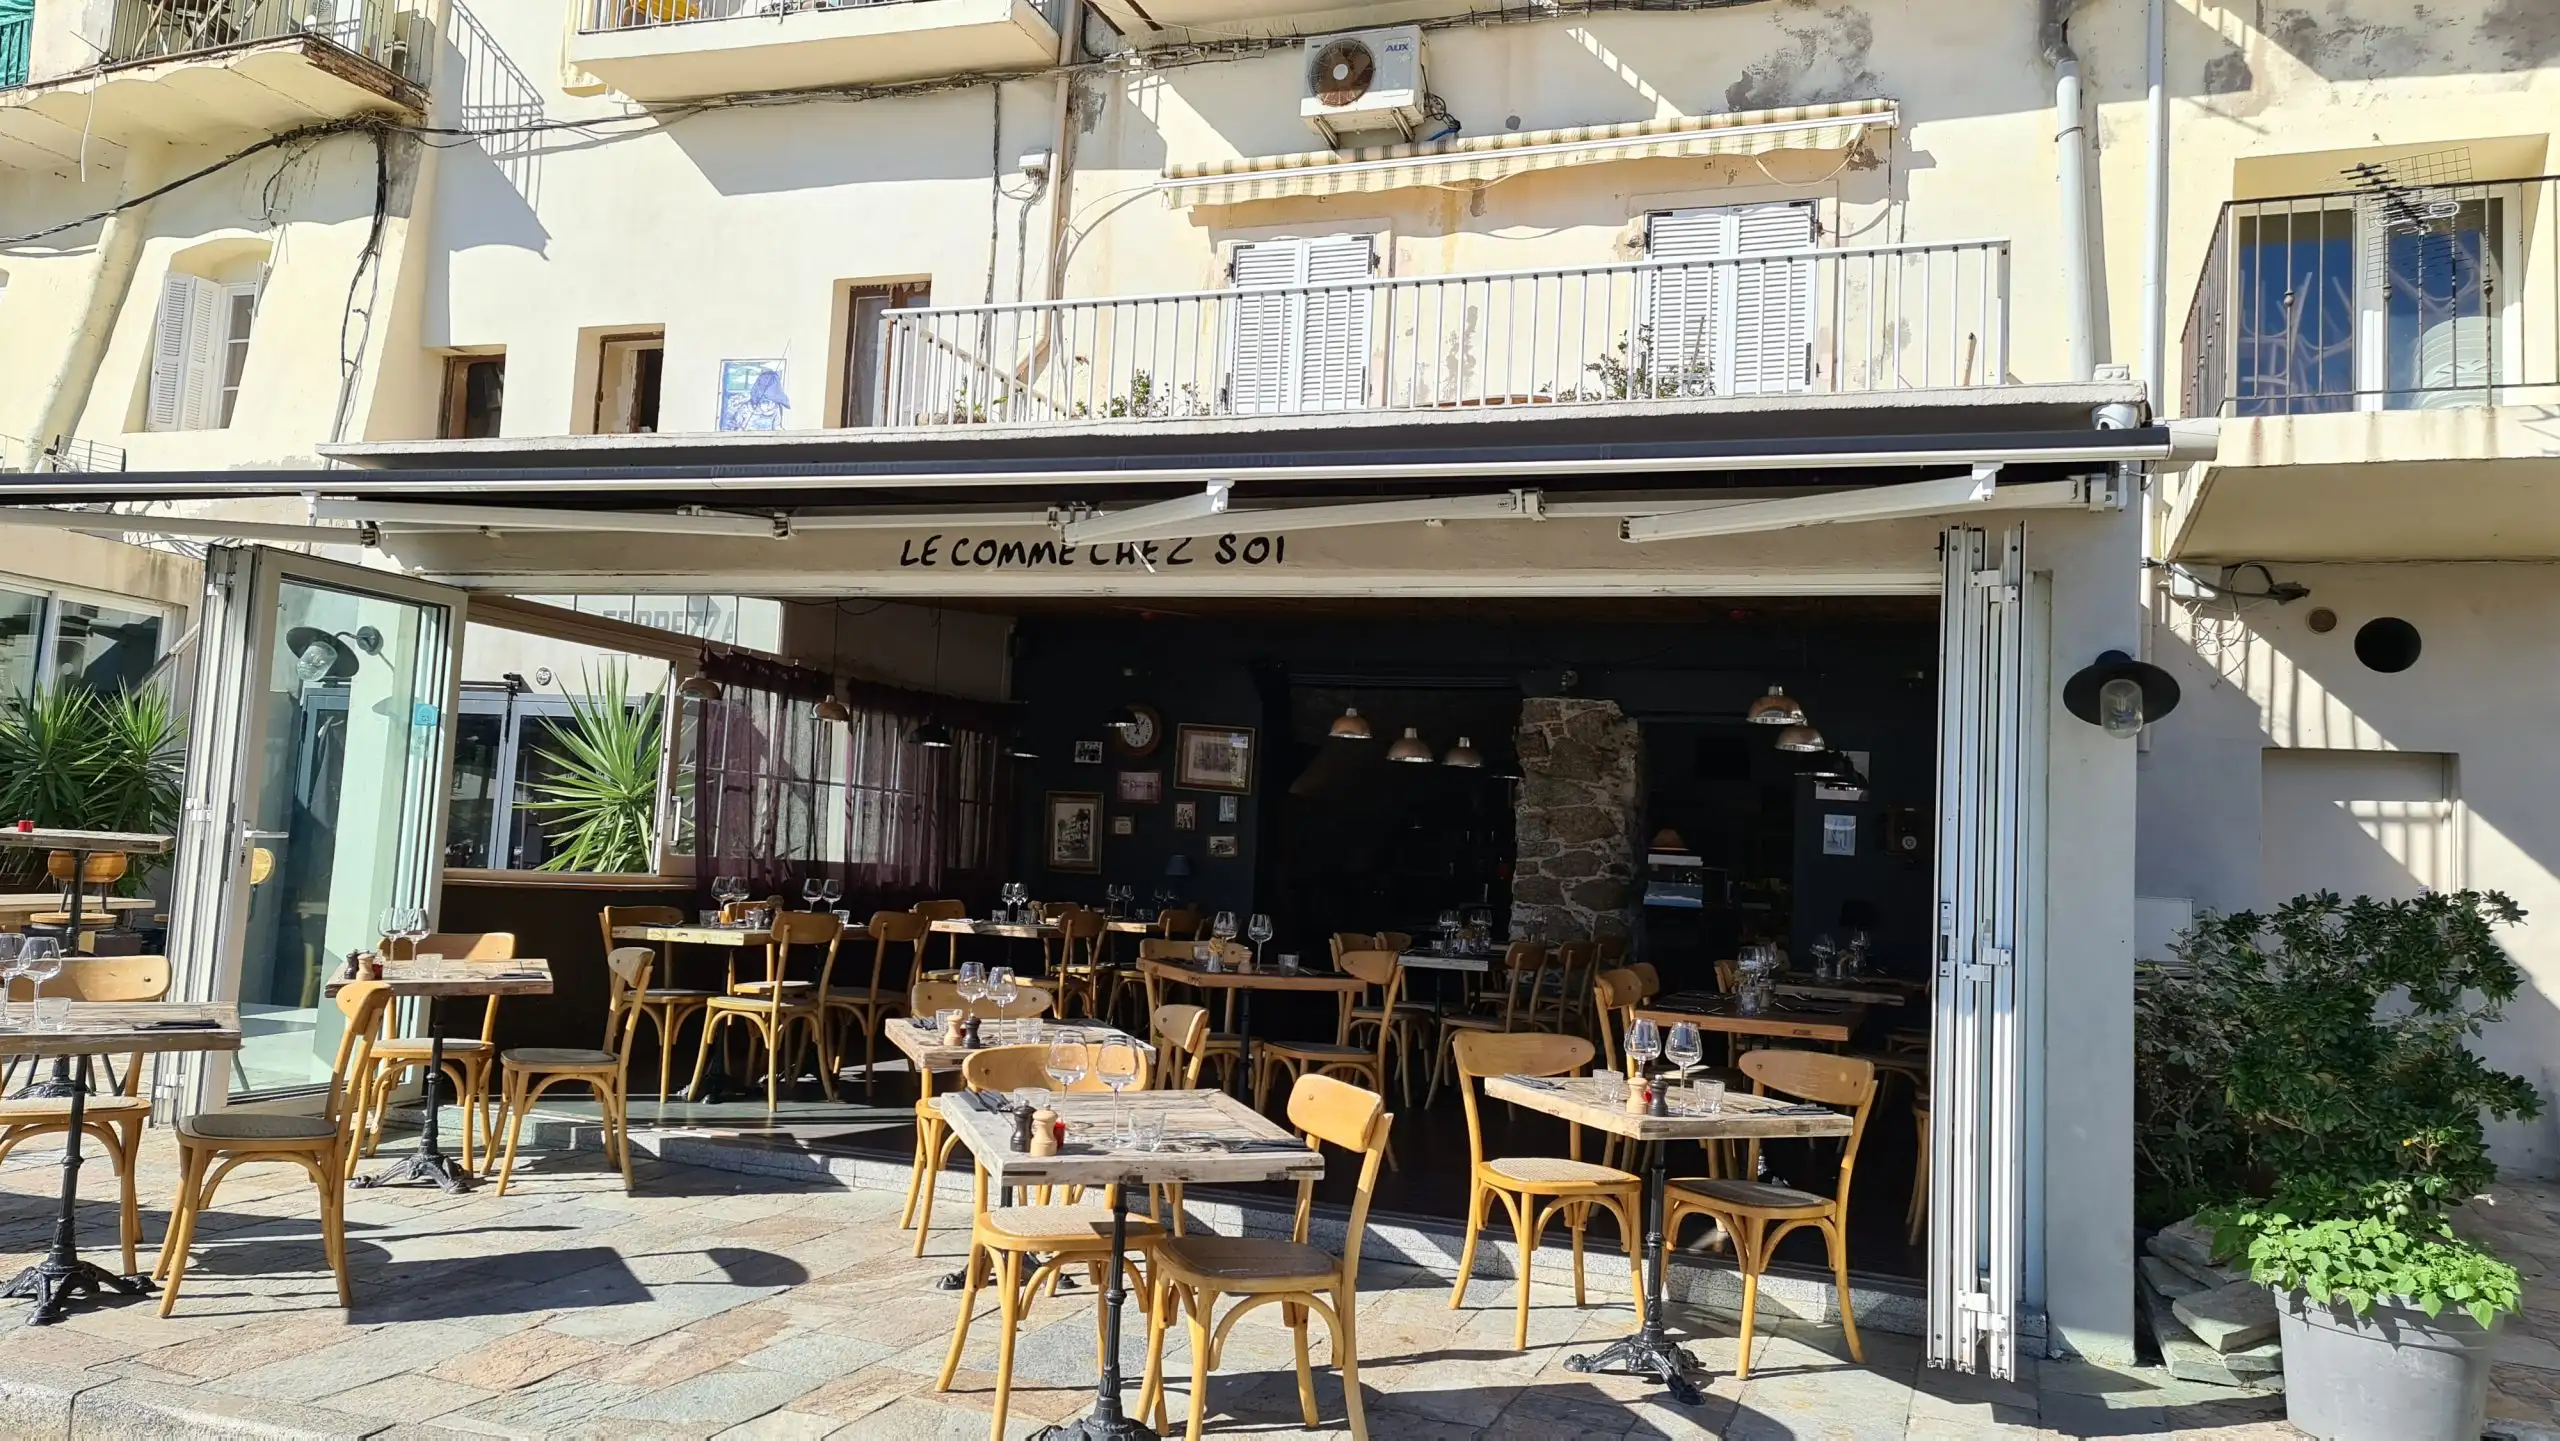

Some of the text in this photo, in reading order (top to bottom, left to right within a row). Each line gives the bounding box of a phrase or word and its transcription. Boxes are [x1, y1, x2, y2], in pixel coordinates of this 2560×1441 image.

[1385, 43, 1409, 52] AUX
[901, 533, 1285, 568] LE COMME CHEZ SOI
